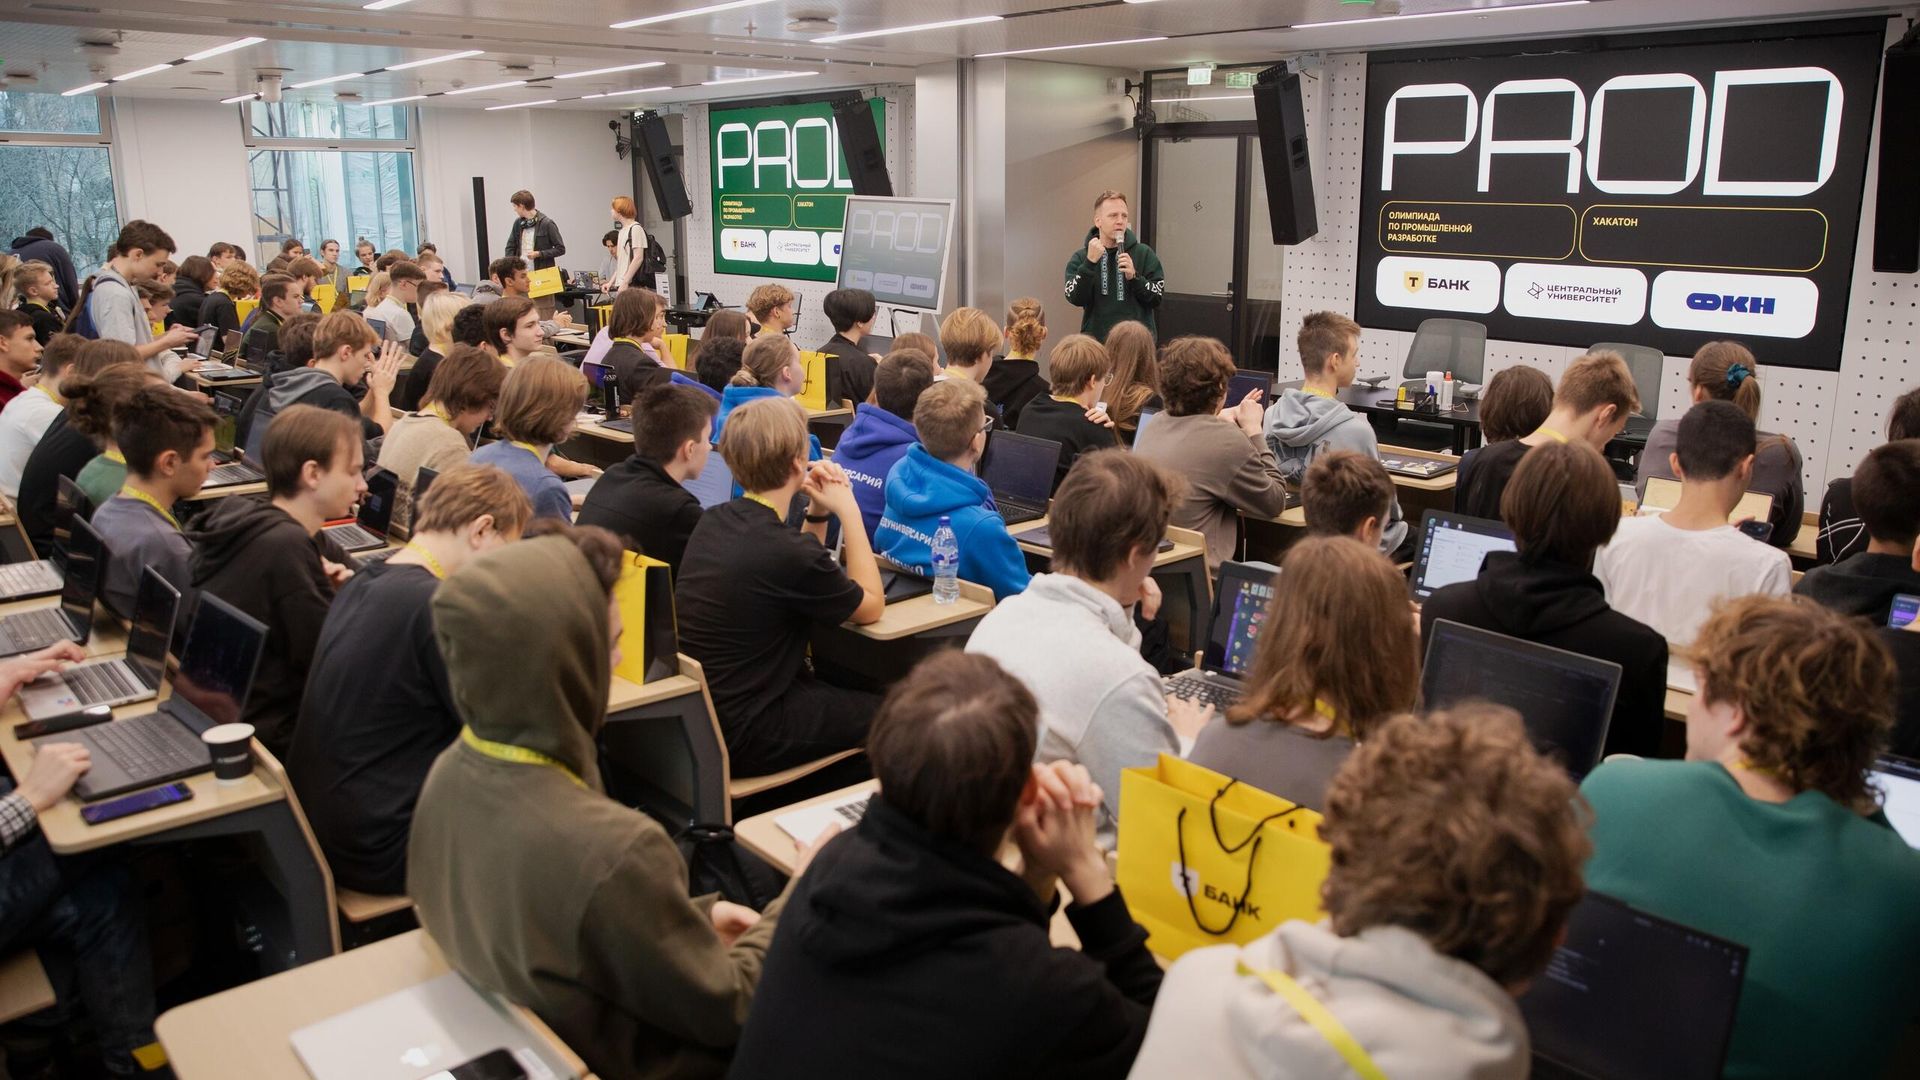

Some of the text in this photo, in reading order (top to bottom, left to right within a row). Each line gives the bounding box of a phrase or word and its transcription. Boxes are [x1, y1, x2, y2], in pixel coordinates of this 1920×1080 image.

[1381, 66, 1844, 196] PROD
[1388, 211, 1441, 221] ОЛИМПИАДА
[1592, 216, 1639, 227] ХАКАТОН
[850, 210, 943, 253] PROD
[1388, 222, 1473, 233] ПО ПРОМЫШЛЕННОЙ
[1387, 233, 1438, 243] РАЗРАБОТКЕ
[740, 241, 757, 249] БАНК
[1427, 278, 1471, 291] БАНК
[1547, 284, 1622, 296] ЦЕНТРАЛЬНЫЙ
[1547, 293, 1618, 304] УНИВЕРСИТЕТ
[1686, 292, 1776, 315] ФКН
[1205, 885, 1260, 920] БАНК
